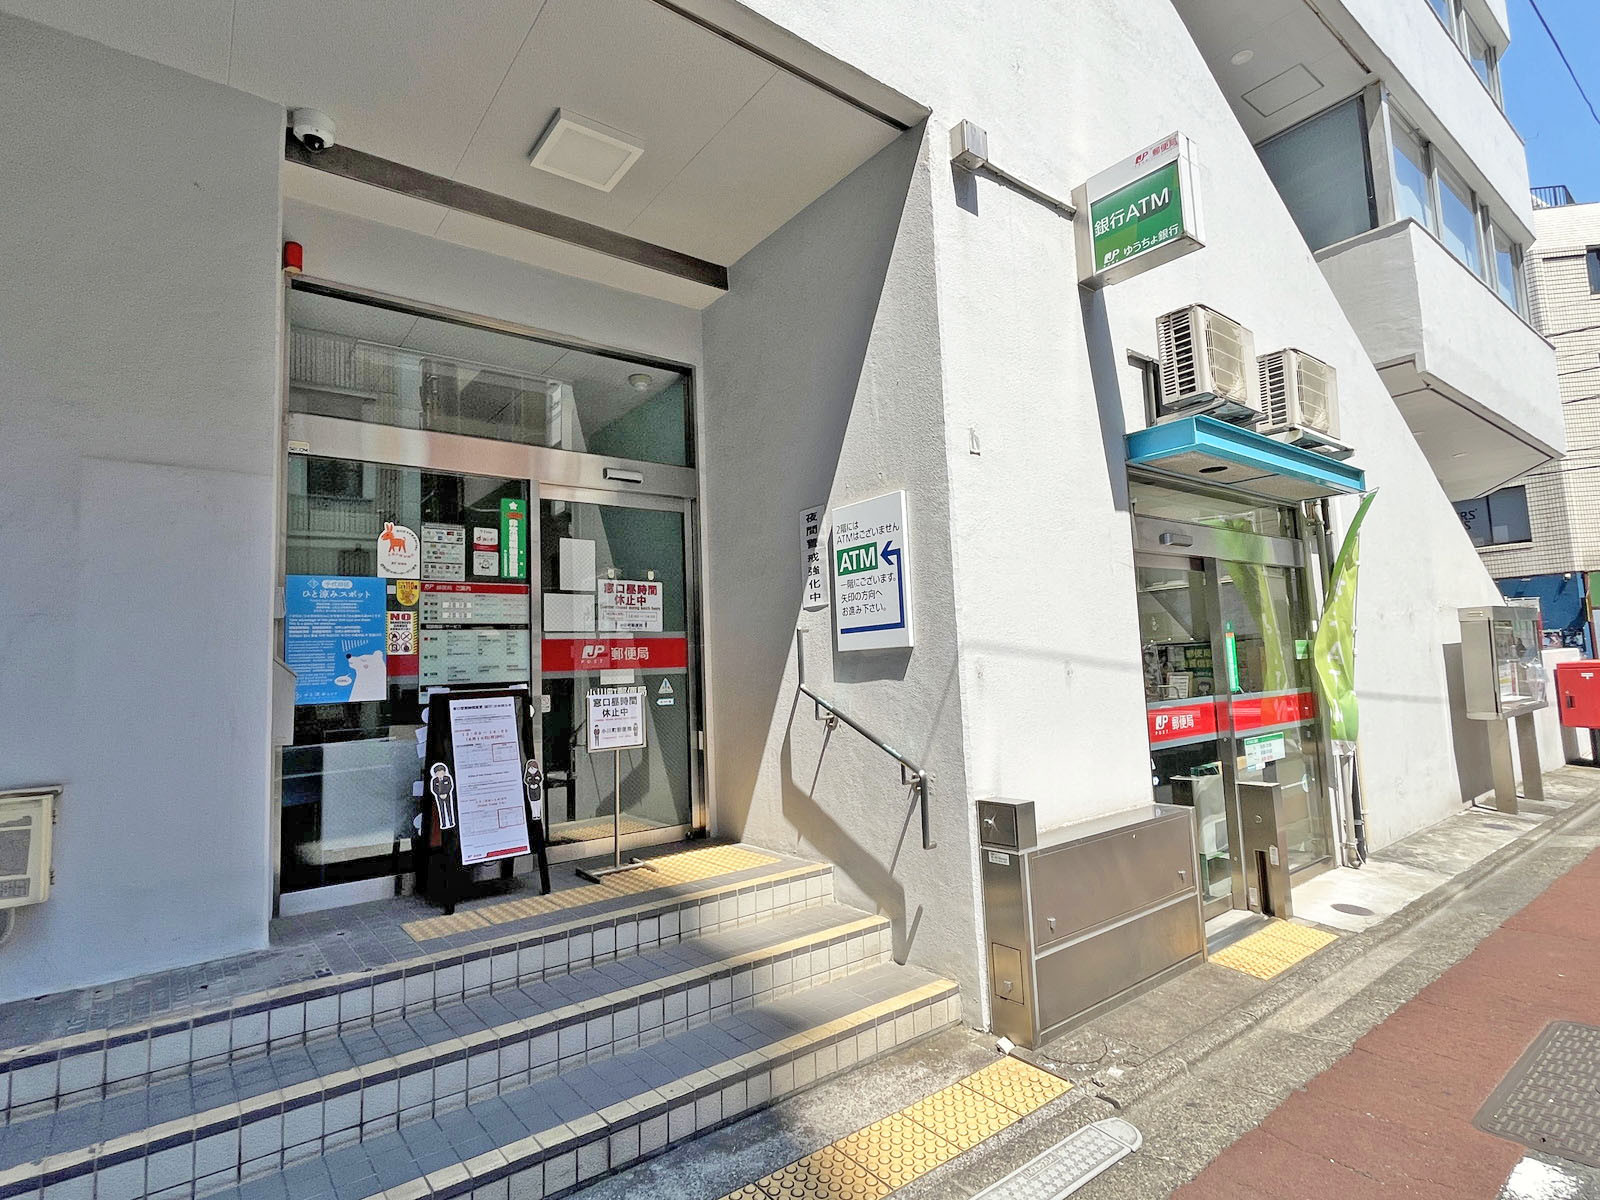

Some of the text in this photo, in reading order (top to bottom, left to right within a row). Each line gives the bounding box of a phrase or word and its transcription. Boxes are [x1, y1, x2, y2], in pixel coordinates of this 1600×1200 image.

[1094, 186, 1170, 237] 銀行ATM
[1123, 223, 1179, 256] ゆうちょ銀行
[836, 521, 859, 535] 2階には
[836, 523, 900, 544] ATMはございません
[839, 546, 876, 573] ATM
[840, 573, 896, 588] 一階にございます。
[302, 590, 371, 599] ひと涼みスポット
[615, 594, 647, 607] 休止中
[841, 589, 883, 604] 矢印の方向へ
[842, 602, 887, 617] お進み下さい。
[611, 647, 649, 660] 郵便局
[602, 708, 629, 718] 休止中
[1171, 715, 1194, 730] 郵便局
